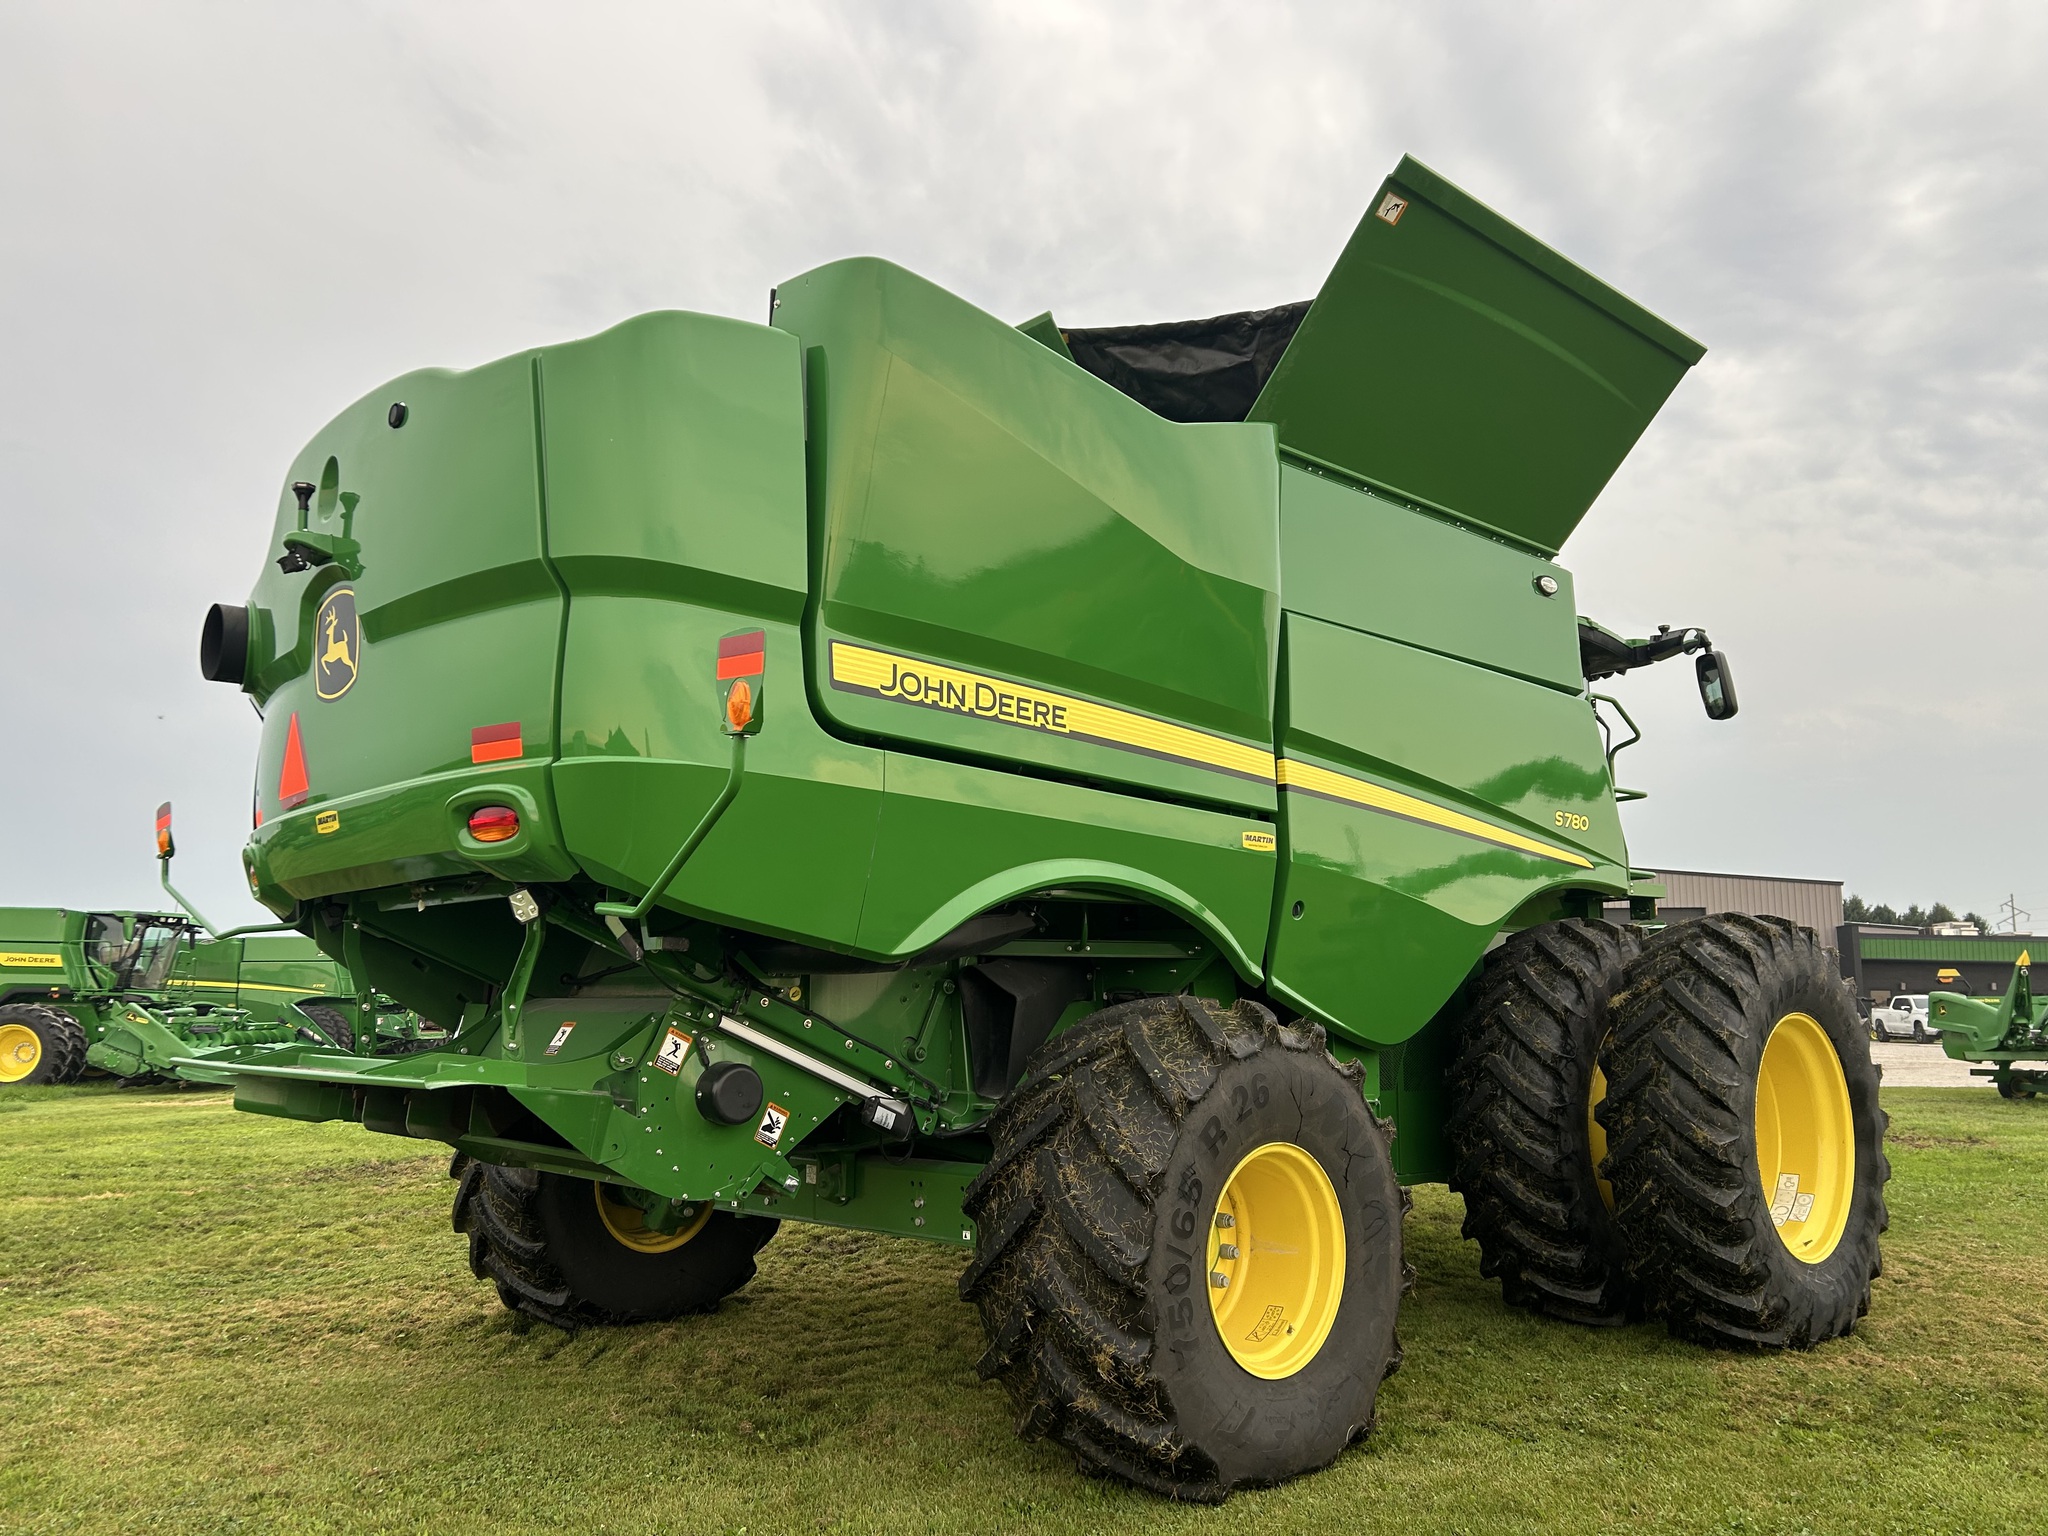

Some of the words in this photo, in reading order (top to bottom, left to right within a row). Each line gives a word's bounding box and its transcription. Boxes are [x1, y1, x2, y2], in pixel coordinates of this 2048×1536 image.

[880, 664, 966, 706] JOHN
[975, 682, 1067, 728] DEERE
[1555, 810, 1589, 831] S780
[1244, 834, 1274, 844] MARTIN
[1231, 1072, 1269, 1122] 26
